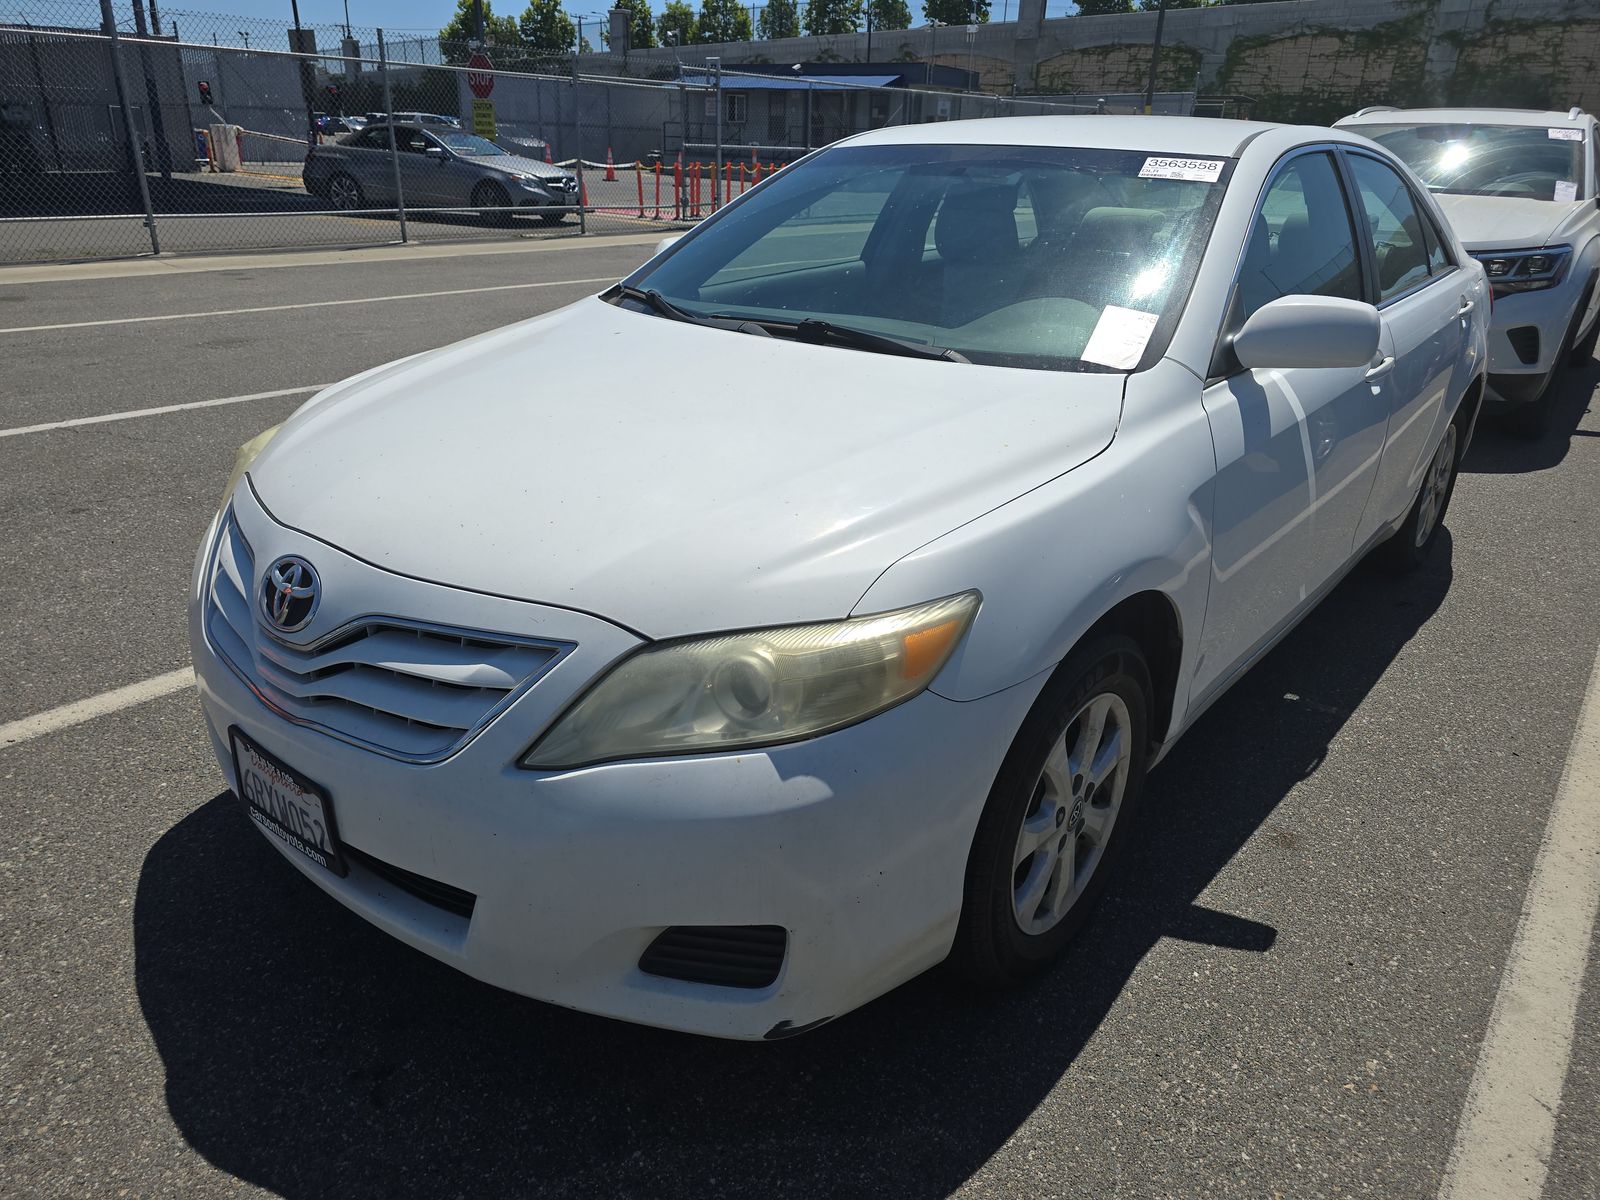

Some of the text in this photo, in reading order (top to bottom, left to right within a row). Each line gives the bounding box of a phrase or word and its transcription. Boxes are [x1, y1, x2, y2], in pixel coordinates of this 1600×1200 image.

[470, 71, 492, 85] STOP
[1148, 158, 1218, 171] 3563558
[249, 805, 327, 867] carsontoyota.com
